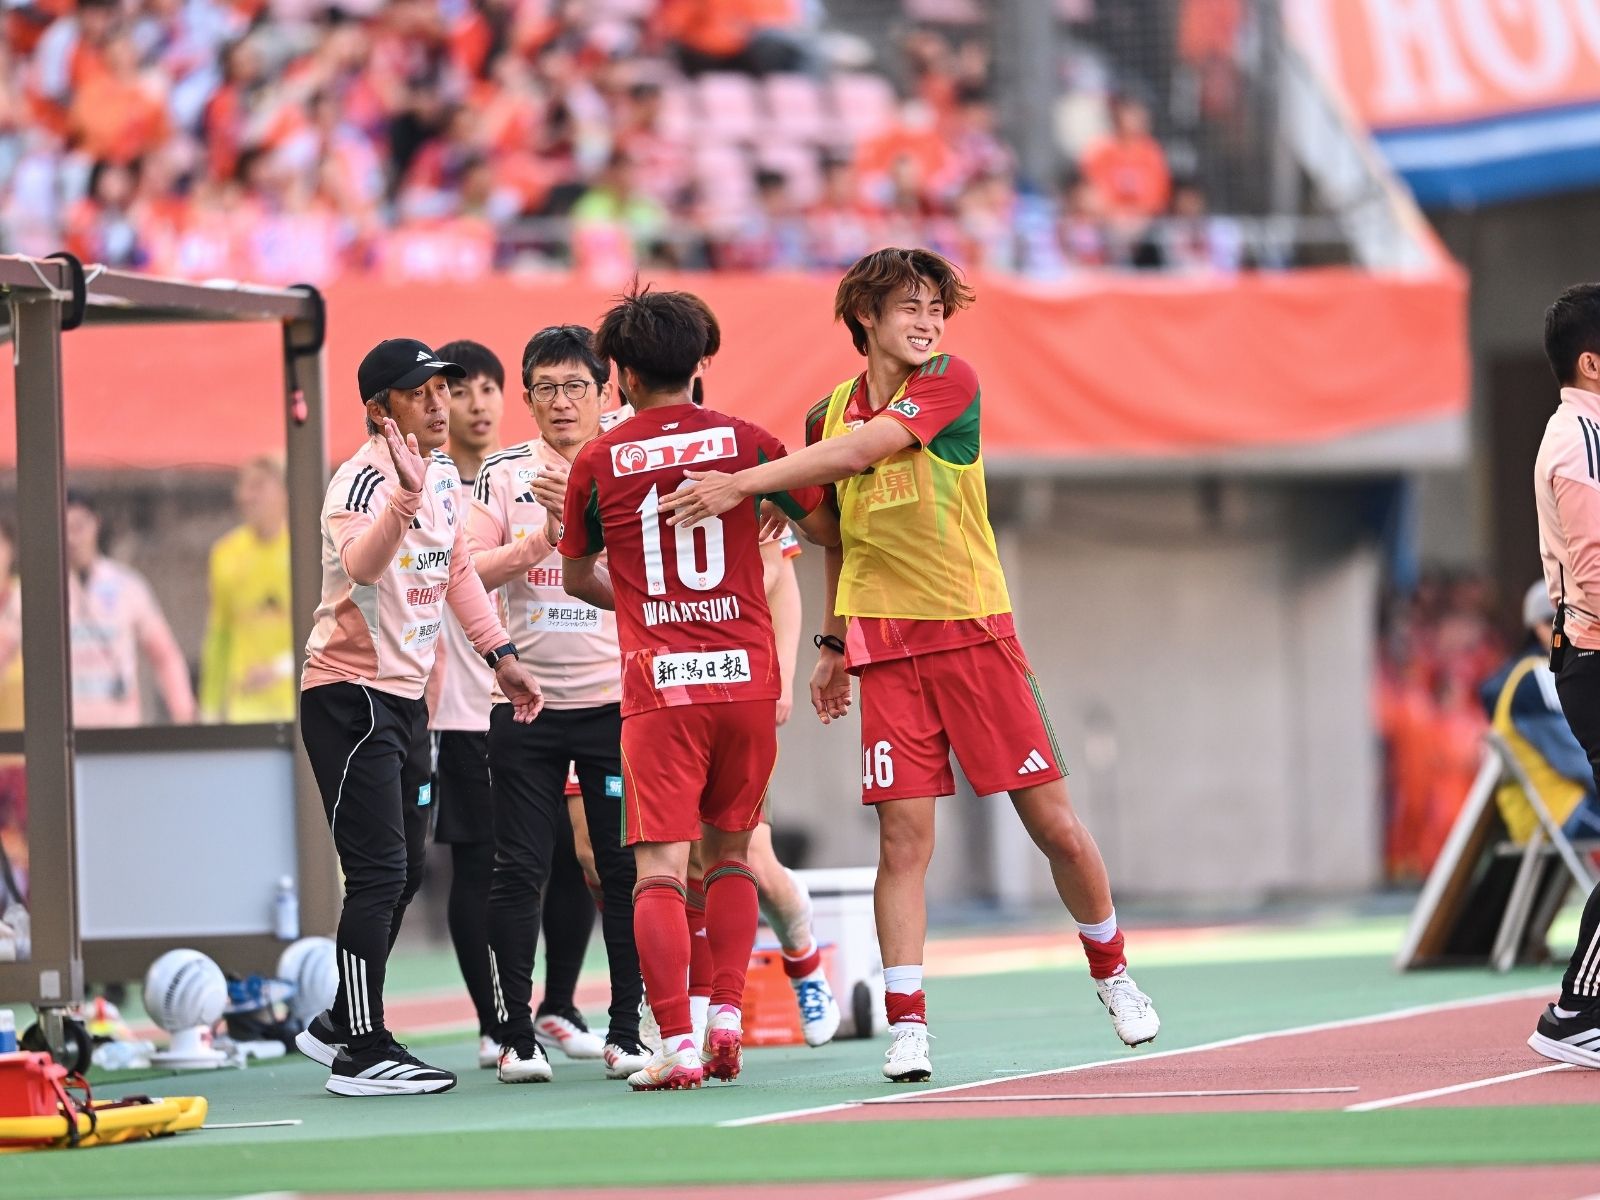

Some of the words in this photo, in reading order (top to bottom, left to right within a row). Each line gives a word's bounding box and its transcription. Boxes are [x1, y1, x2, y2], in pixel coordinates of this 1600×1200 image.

[648, 437, 735, 468] コメリ
[548, 608, 598, 620] 第四北越
[643, 596, 740, 626] WAKATSUKI
[863, 740, 894, 789] 46
